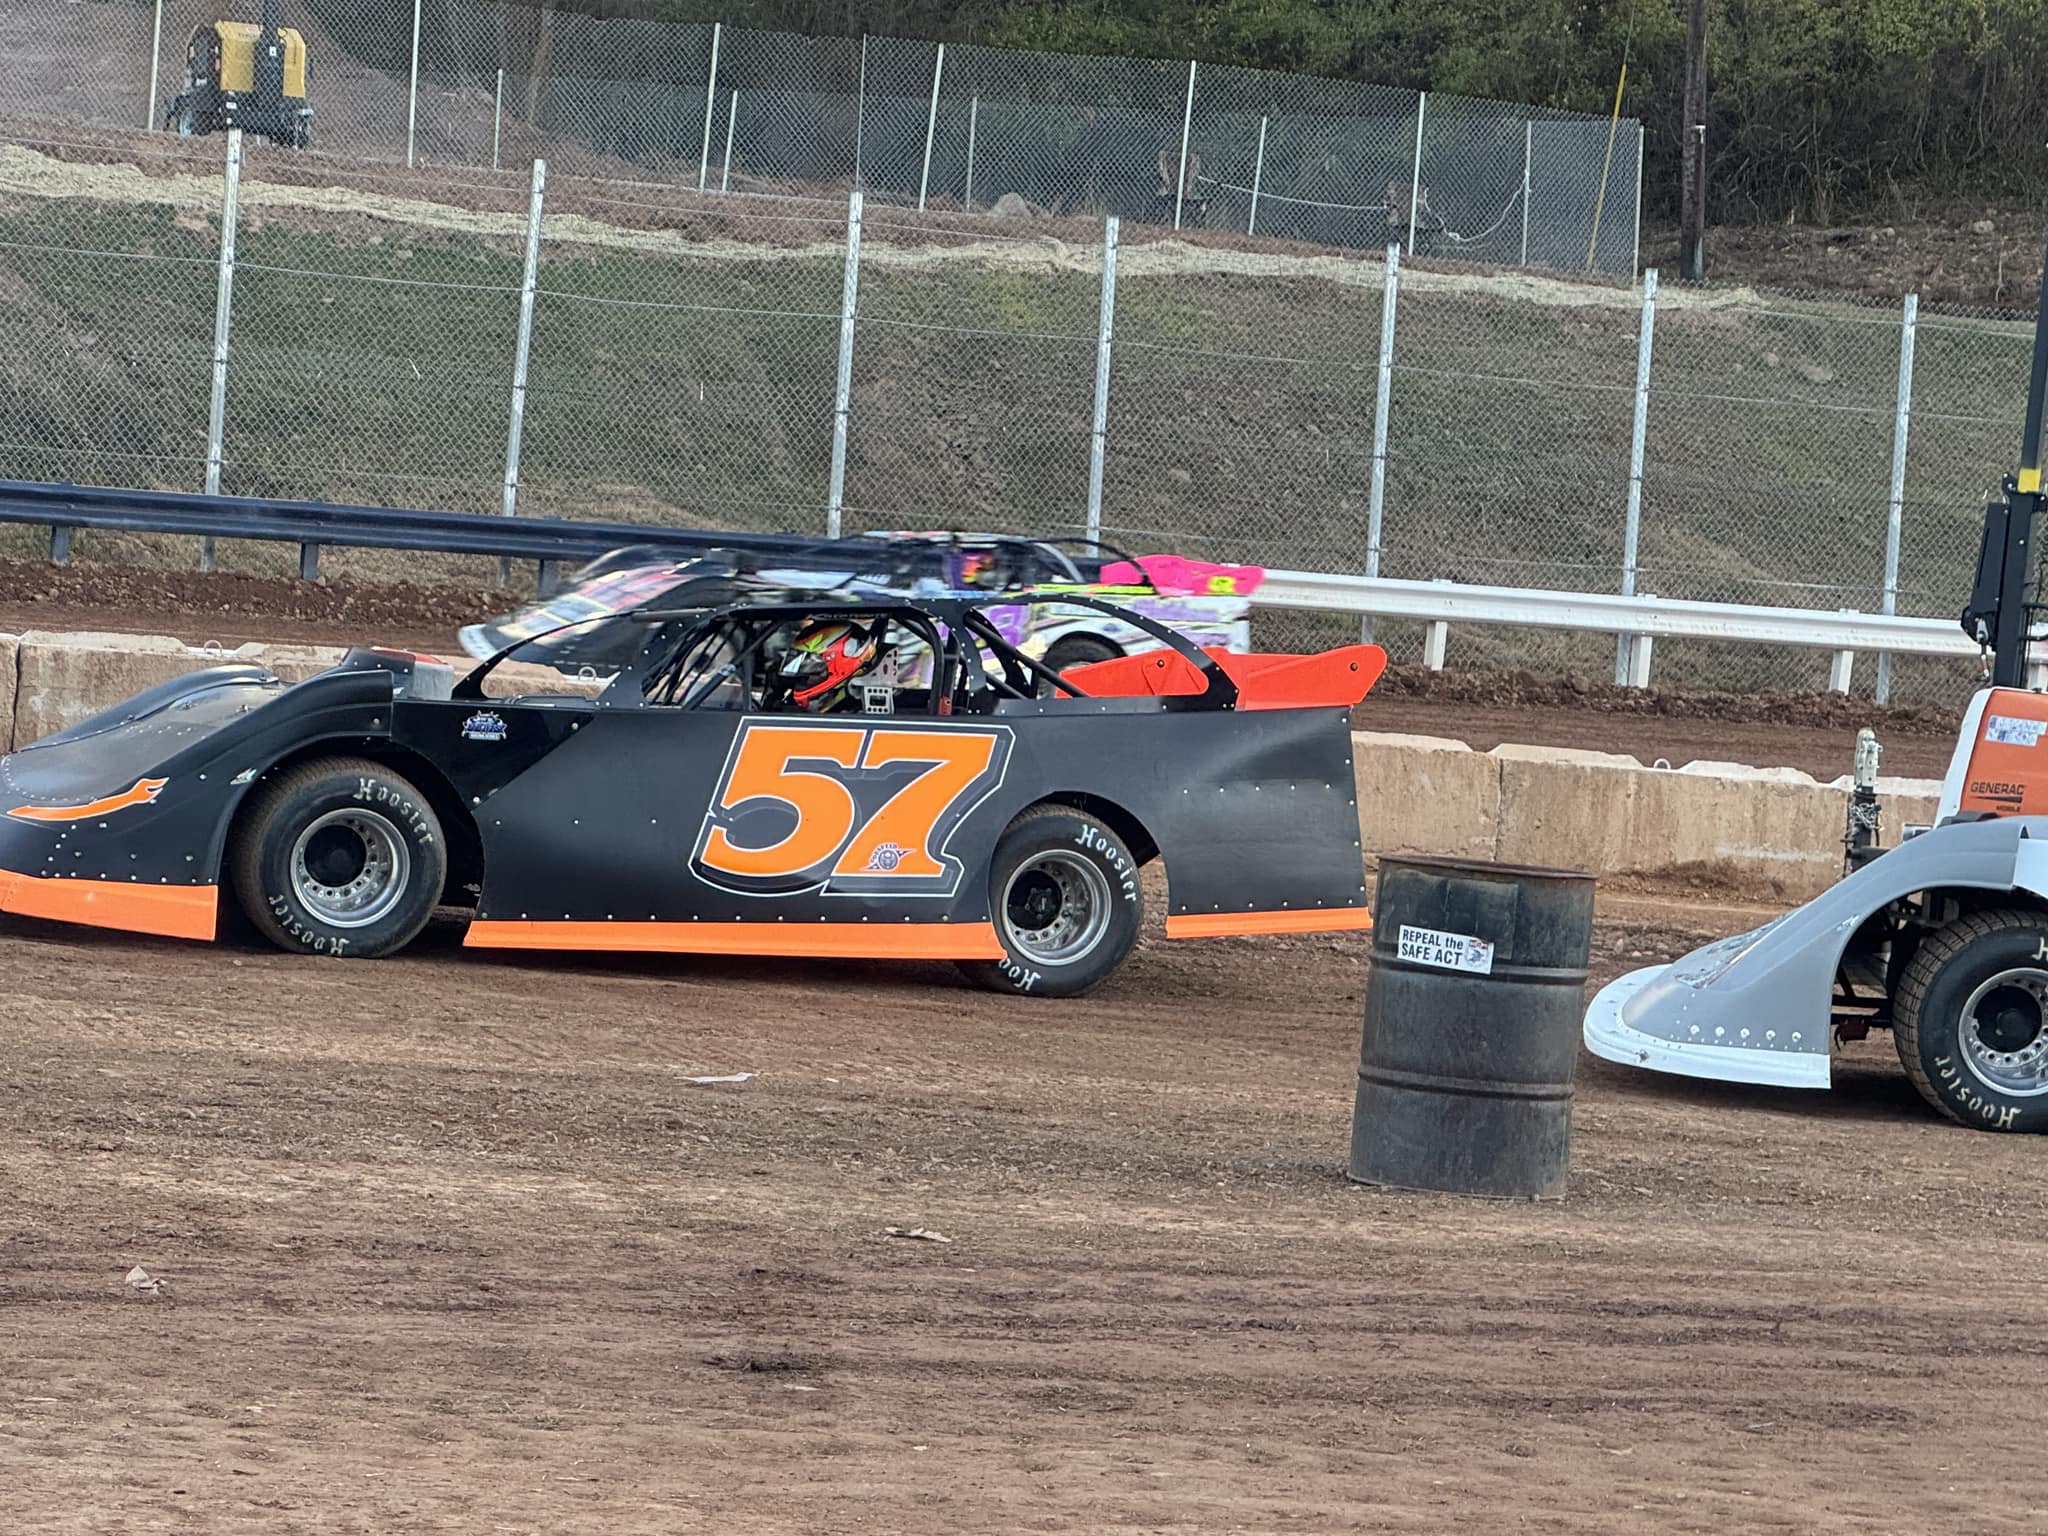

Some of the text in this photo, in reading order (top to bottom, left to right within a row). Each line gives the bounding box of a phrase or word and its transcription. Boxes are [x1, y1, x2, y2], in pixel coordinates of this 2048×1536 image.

[353, 777, 433, 845] Hoosier
[699, 725, 1000, 879] 57
[1970, 781, 2026, 796] GENERAC
[1075, 824, 1137, 902] Hoosier
[268, 894, 350, 957] Hoosier
[1401, 943, 1431, 960] SAFE
[1433, 949, 1463, 966] ACT
[1402, 929, 1464, 951] REPEAL the
[1934, 1055, 2022, 1130] Hoosier
